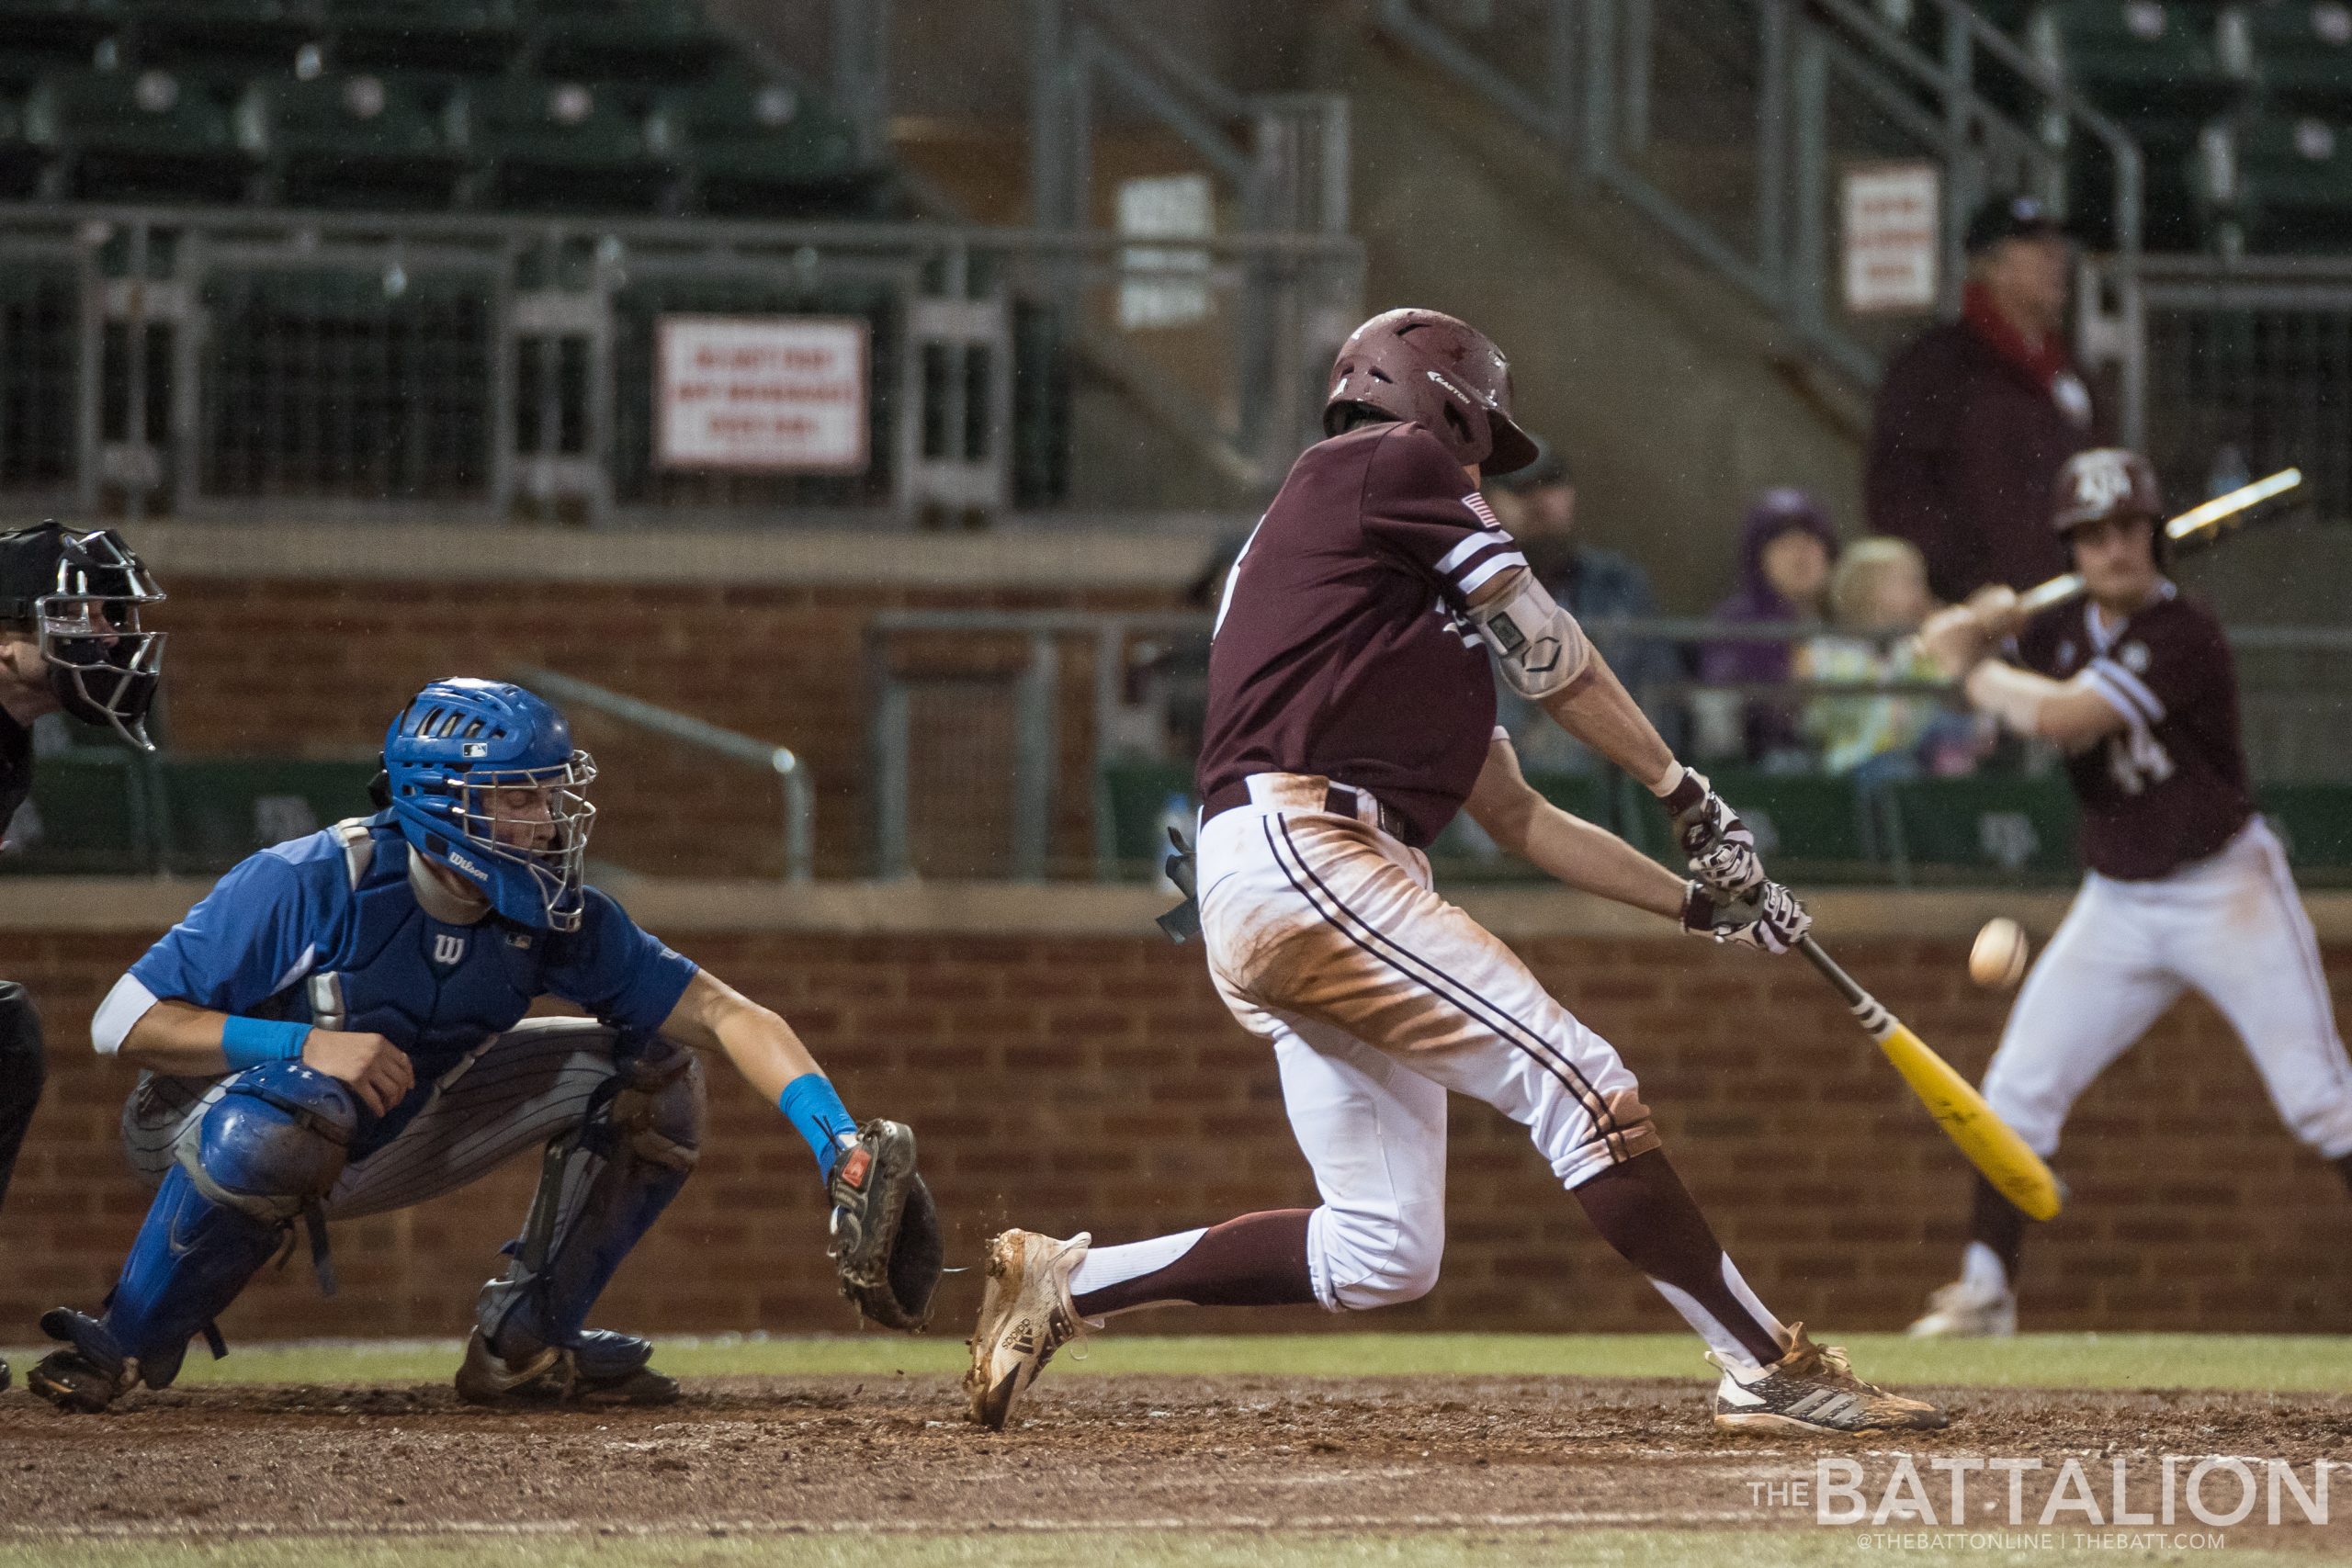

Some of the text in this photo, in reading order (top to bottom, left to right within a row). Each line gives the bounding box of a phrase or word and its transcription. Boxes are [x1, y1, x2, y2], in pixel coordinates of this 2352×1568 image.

[1435, 377, 1471, 404] EASTON
[449, 851, 489, 882] Wilson
[1002, 1318, 1030, 1349] adidas
